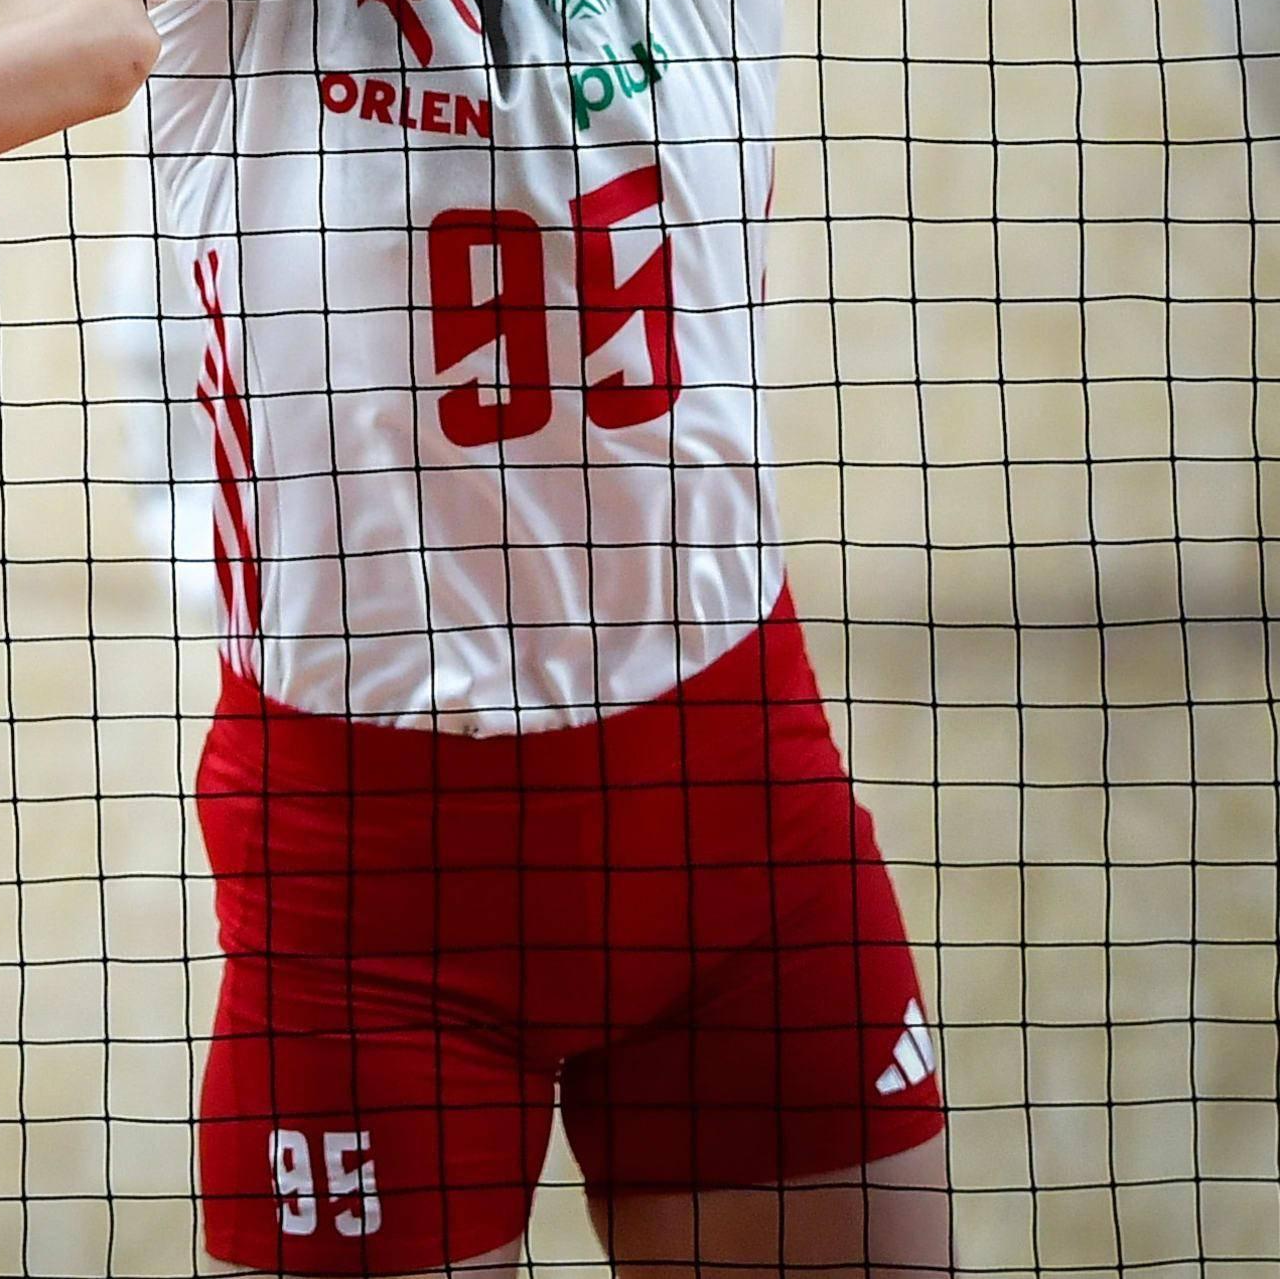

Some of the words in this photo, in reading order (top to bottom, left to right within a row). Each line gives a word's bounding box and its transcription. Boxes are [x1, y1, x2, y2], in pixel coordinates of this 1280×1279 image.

[320, 72, 492, 139] ORLEN
[427, 164, 681, 448] 95
[268, 1128, 382, 1236] 95
